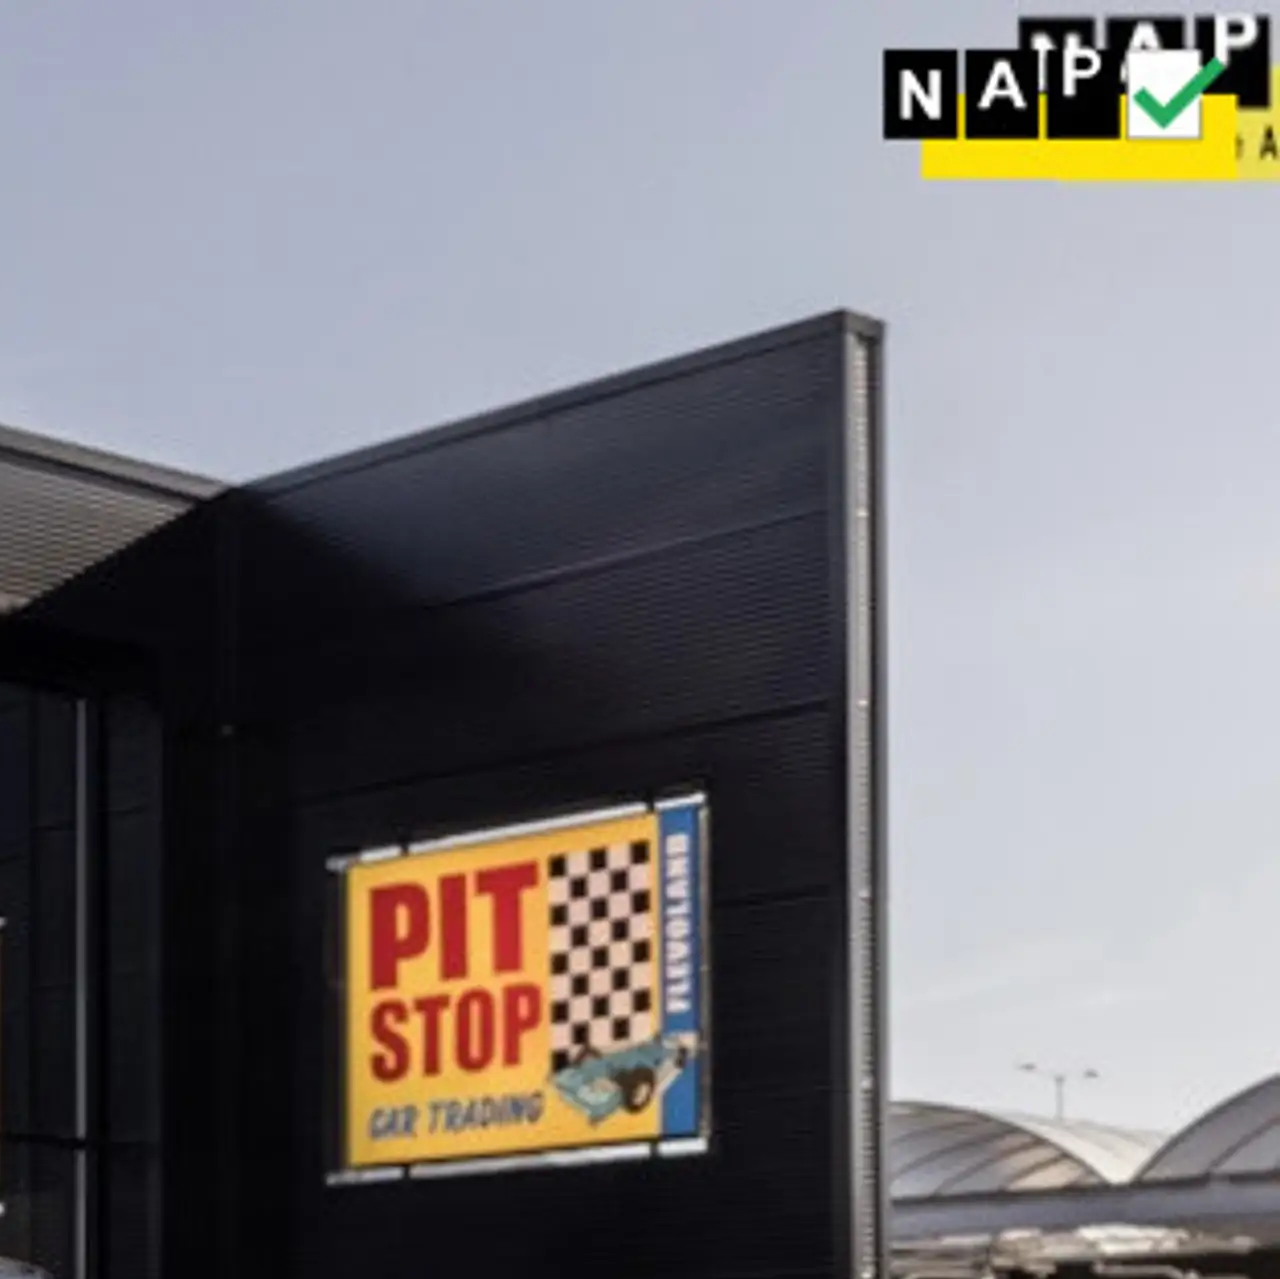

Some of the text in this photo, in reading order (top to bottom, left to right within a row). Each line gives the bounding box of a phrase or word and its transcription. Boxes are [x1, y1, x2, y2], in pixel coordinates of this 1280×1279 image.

[369, 860, 540, 991] PIT
[369, 982, 543, 1084] STOP
[369, 1104, 419, 1140] CAR
